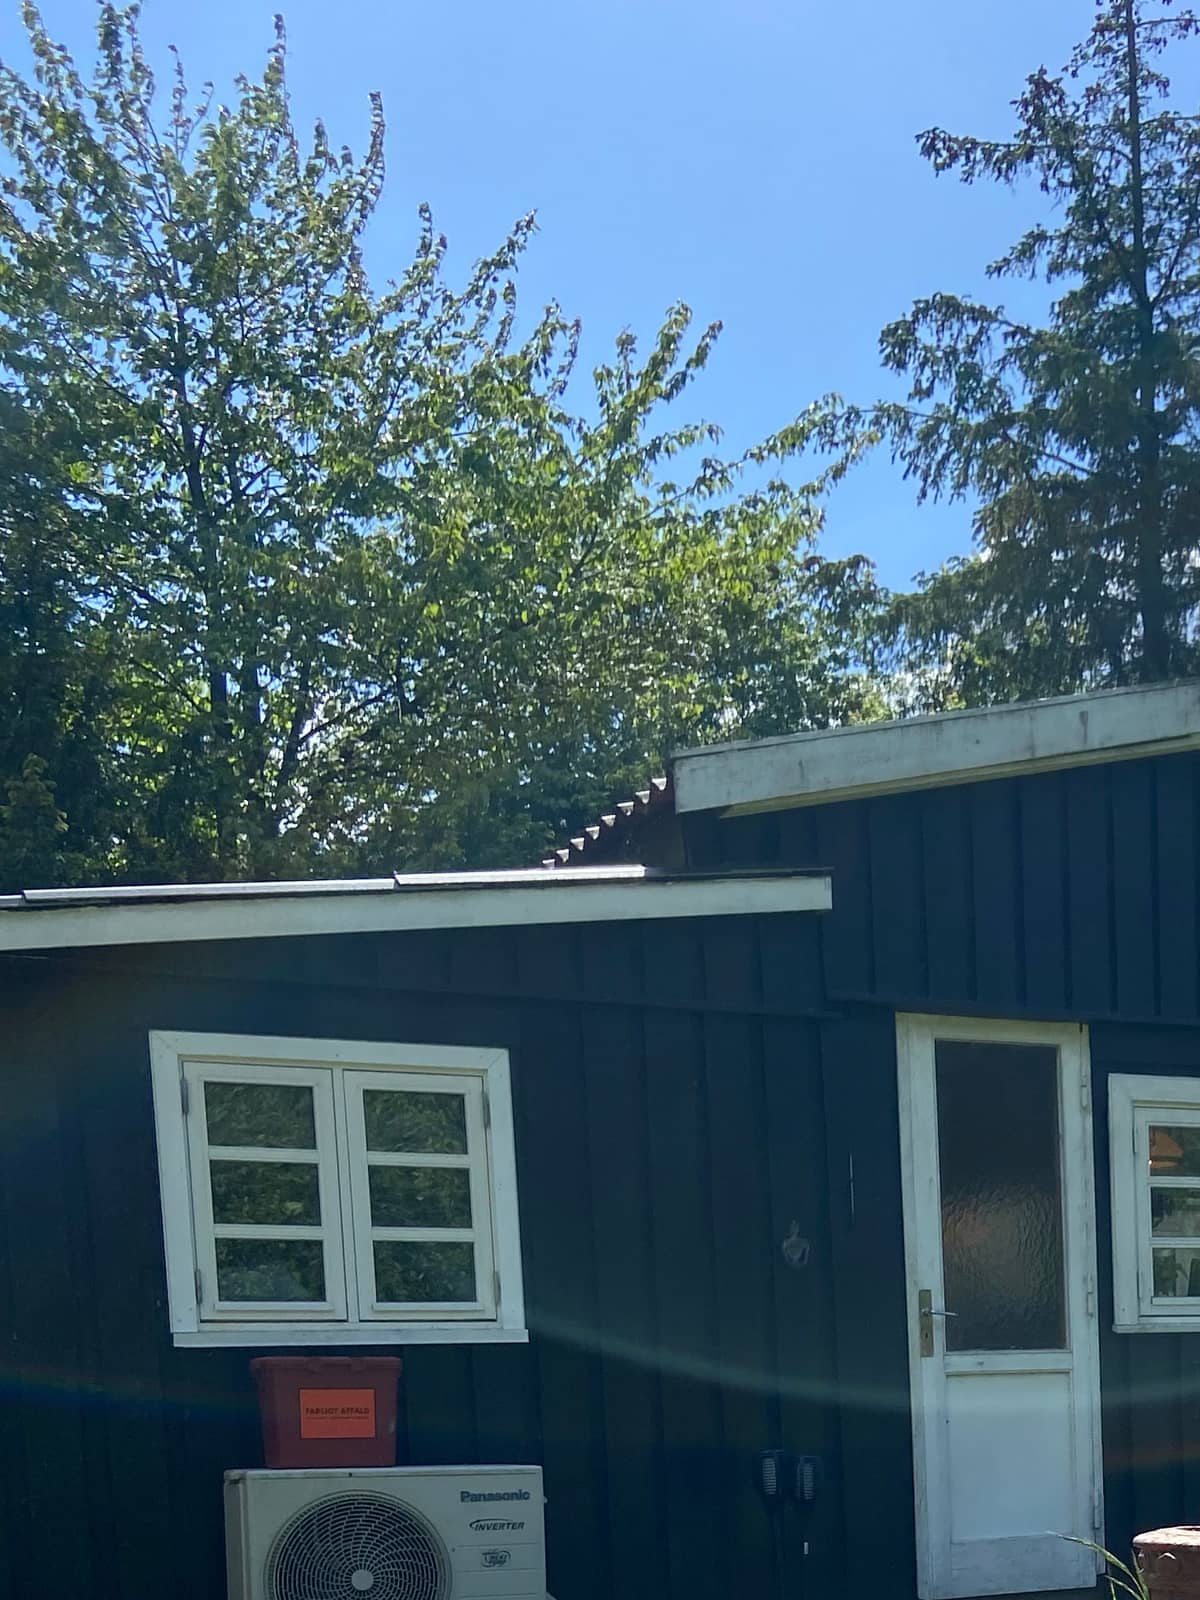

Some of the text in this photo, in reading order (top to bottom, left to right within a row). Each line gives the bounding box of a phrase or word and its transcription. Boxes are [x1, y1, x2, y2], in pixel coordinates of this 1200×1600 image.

[340, 1407, 370, 1415] AFFALD
[460, 1489, 530, 1503] Panasonic
[473, 1521, 525, 1531] INVERTER
